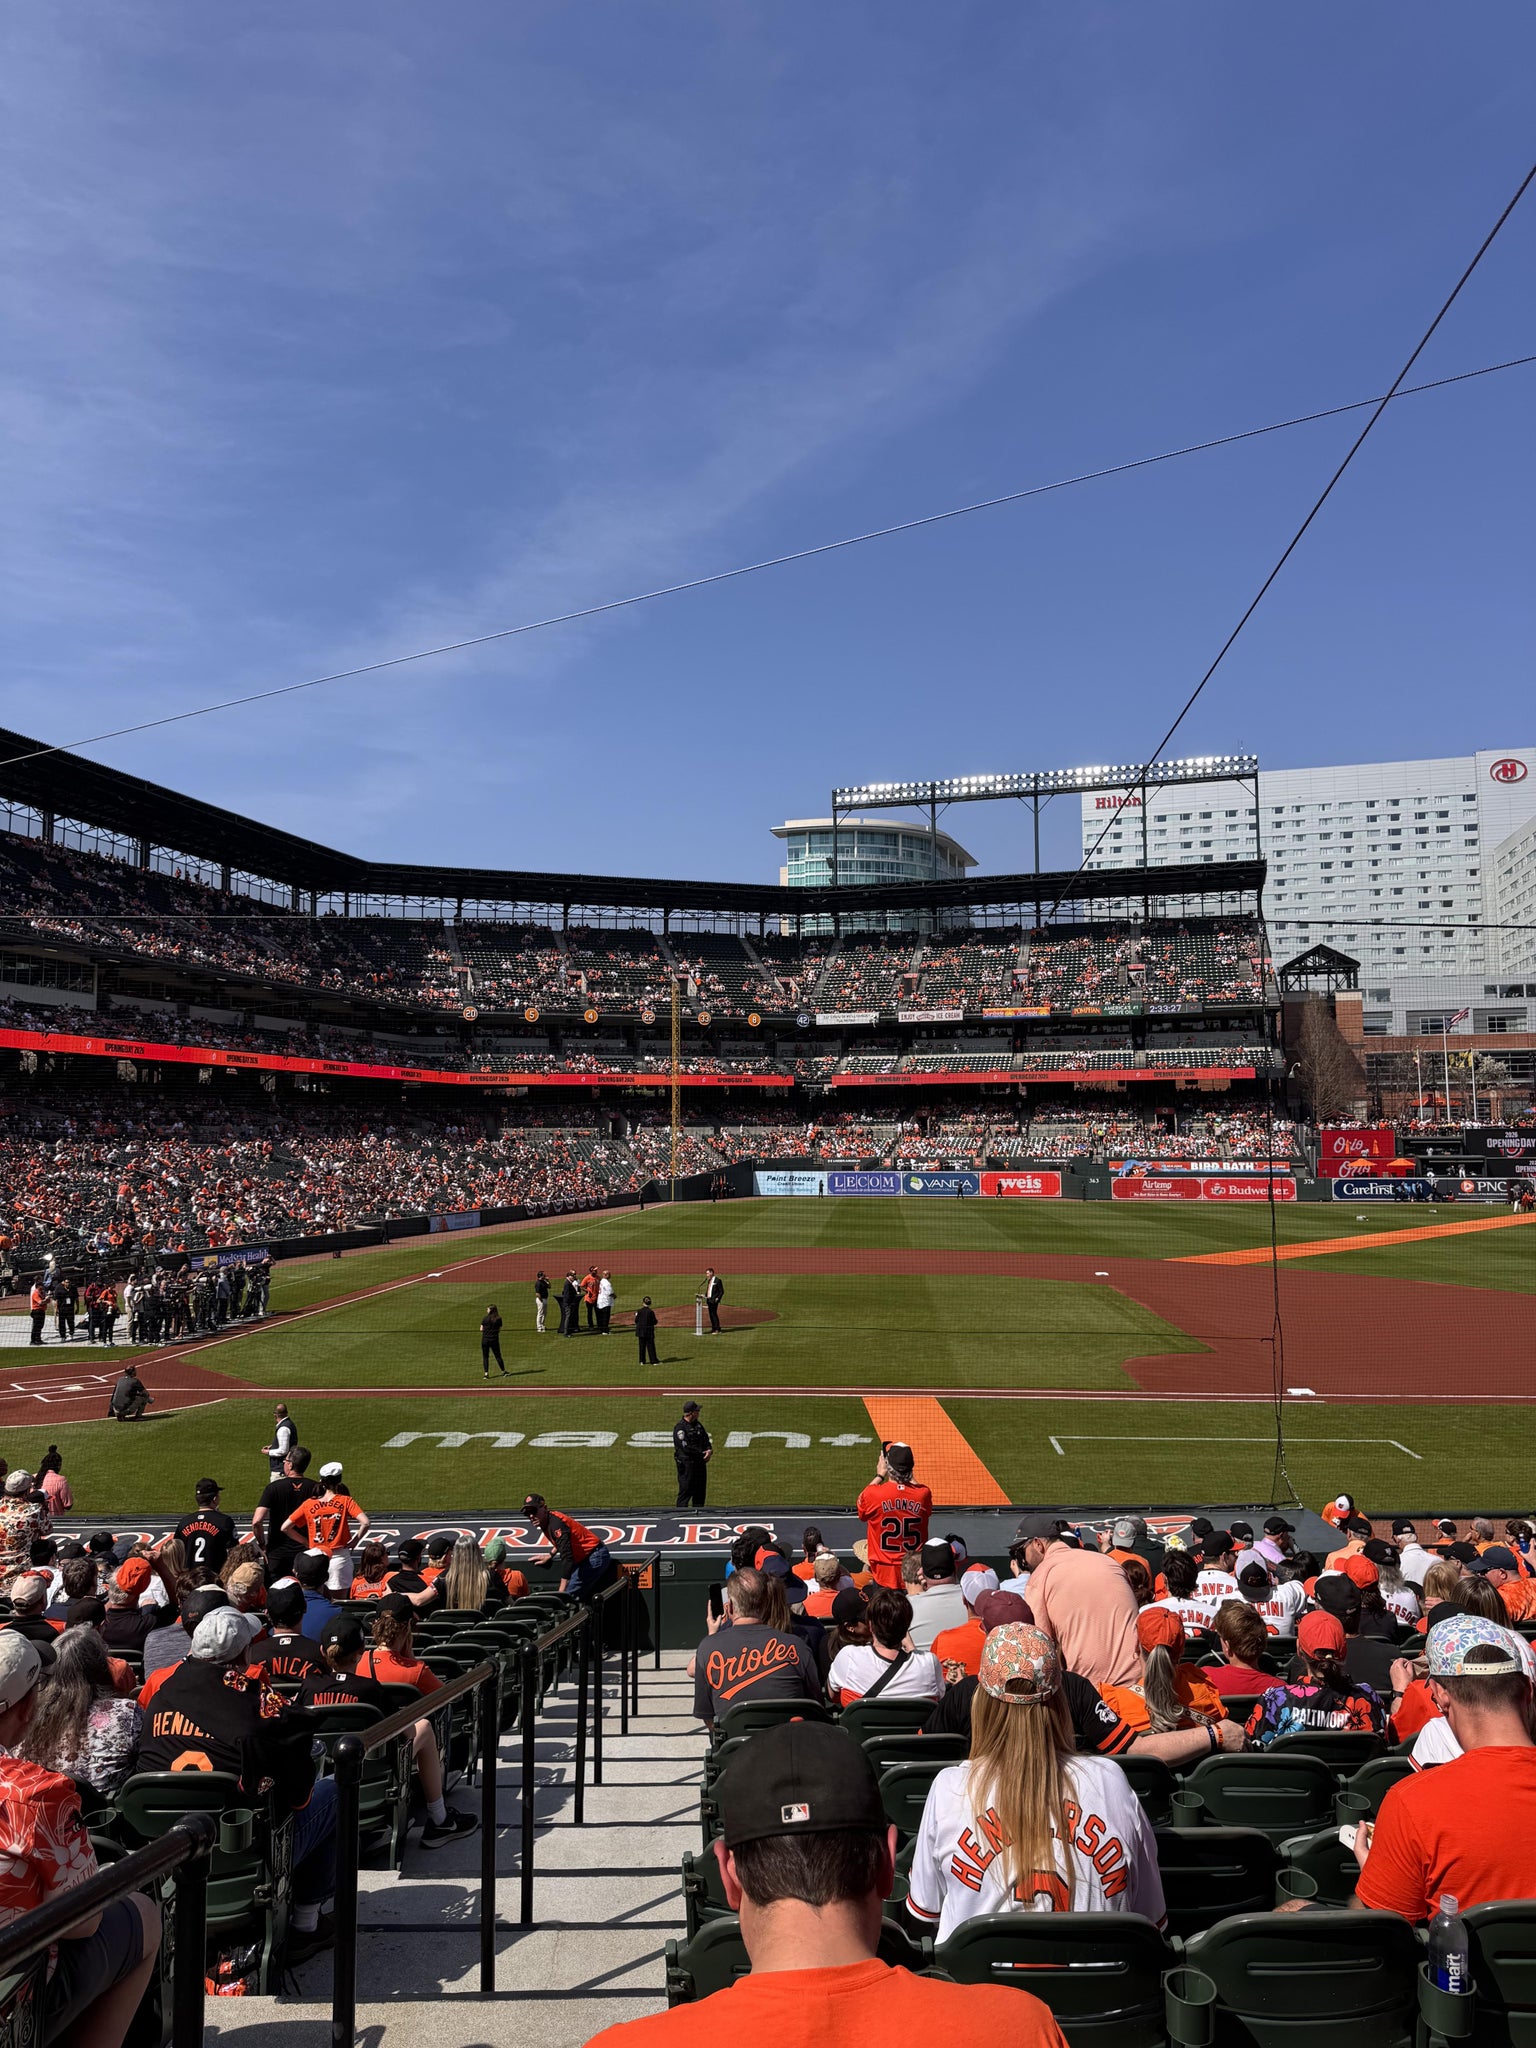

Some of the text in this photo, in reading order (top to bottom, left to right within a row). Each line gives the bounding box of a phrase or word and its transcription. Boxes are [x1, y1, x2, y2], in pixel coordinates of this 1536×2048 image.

[1095, 795, 1142, 809] Hilton
[1149, 1004, 1182, 1013] 2:33:27
[1486, 1138, 1536, 1148] OPENING DAY
[1191, 1162, 1219, 1170] BIRD
[1223, 1162, 1254, 1170] BATH
[1515, 1165, 1536, 1173] OPENIN
[1000, 1175, 1042, 1190] weis
[1142, 1180, 1172, 1190] Airtemp
[1343, 1182, 1395, 1195] CareFirst
[1477, 1181, 1508, 1192] PNC
[220, 1249, 269, 1264] MedStar Health
[310, 1499, 344, 1515] COWSER
[881, 1499, 922, 1513] ALONSO
[182, 1525, 220, 1537] HENDERSON
[313, 1514, 342, 1544] 17
[881, 1517, 922, 1551] 25
[194, 1537, 206, 1561] 2
[1189, 1583, 1234, 1597] EAVER
[1251, 1601, 1285, 1617] CINI
[1387, 1603, 1417, 1626] ERSON
[271, 1656, 322, 1679] NICK
[706, 1638, 800, 1693] Orioles
[153, 1711, 213, 1739] HEND
[951, 1798, 1129, 1899] HENRSON
[1446, 1953, 1460, 1993] mart
